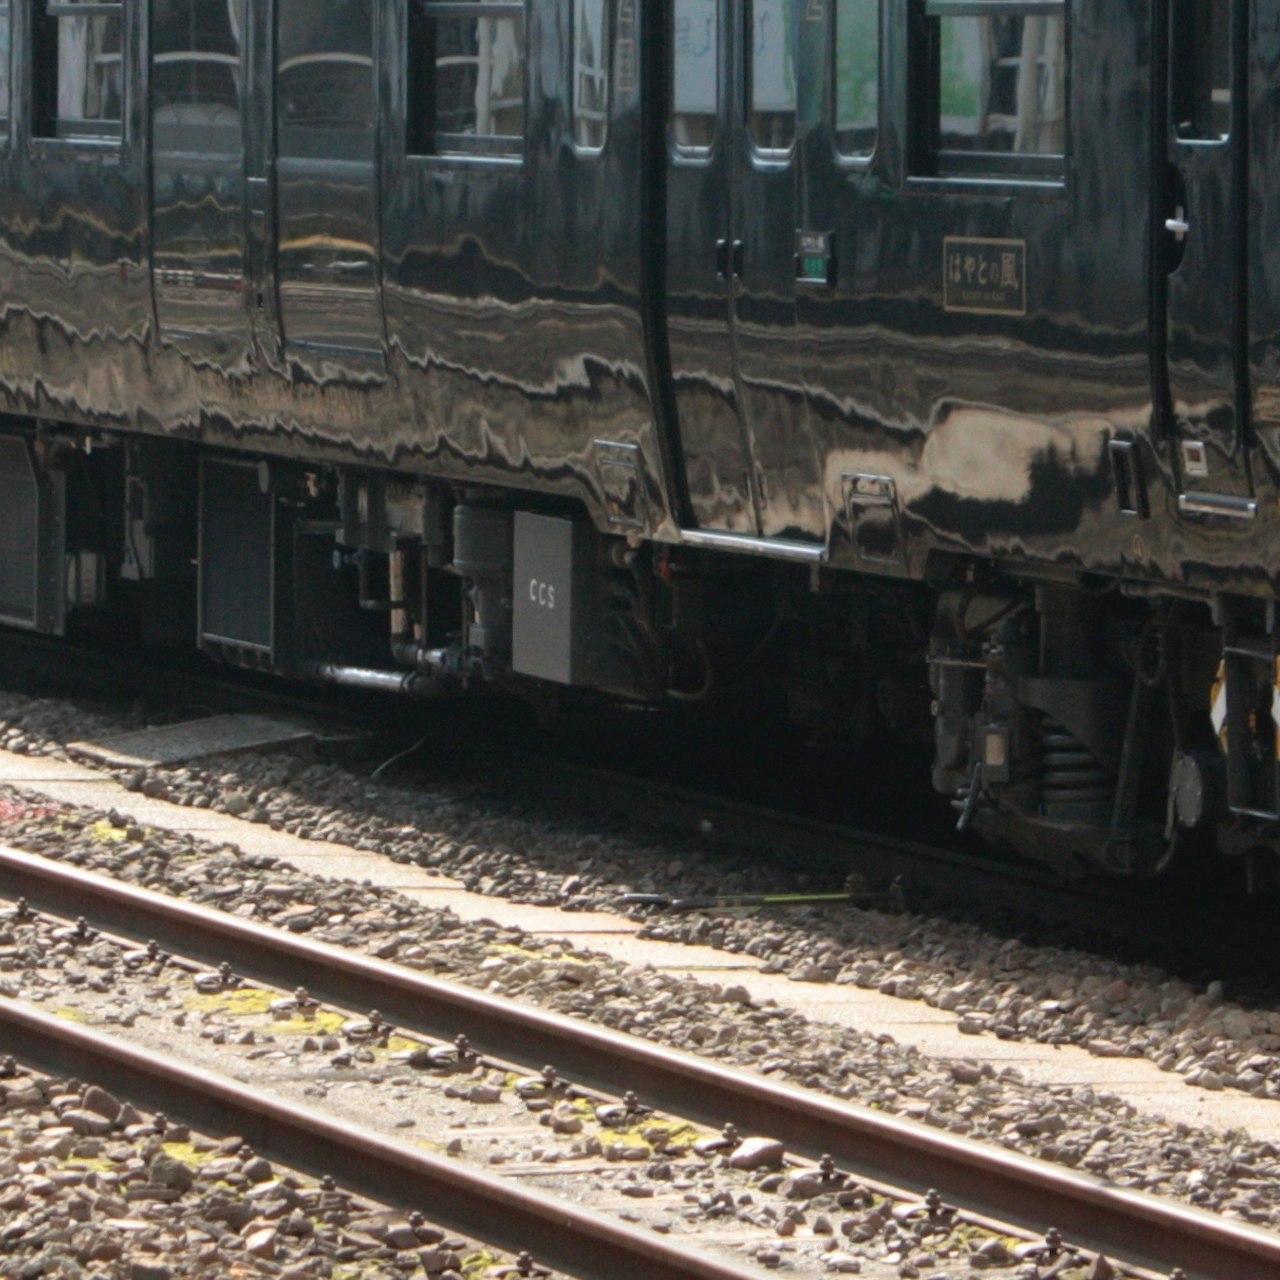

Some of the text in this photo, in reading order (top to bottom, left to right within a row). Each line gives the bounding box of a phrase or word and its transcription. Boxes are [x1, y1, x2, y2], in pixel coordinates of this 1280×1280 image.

[949, 252, 1018, 291] はやとの風
[529, 578, 555, 609] CCS
